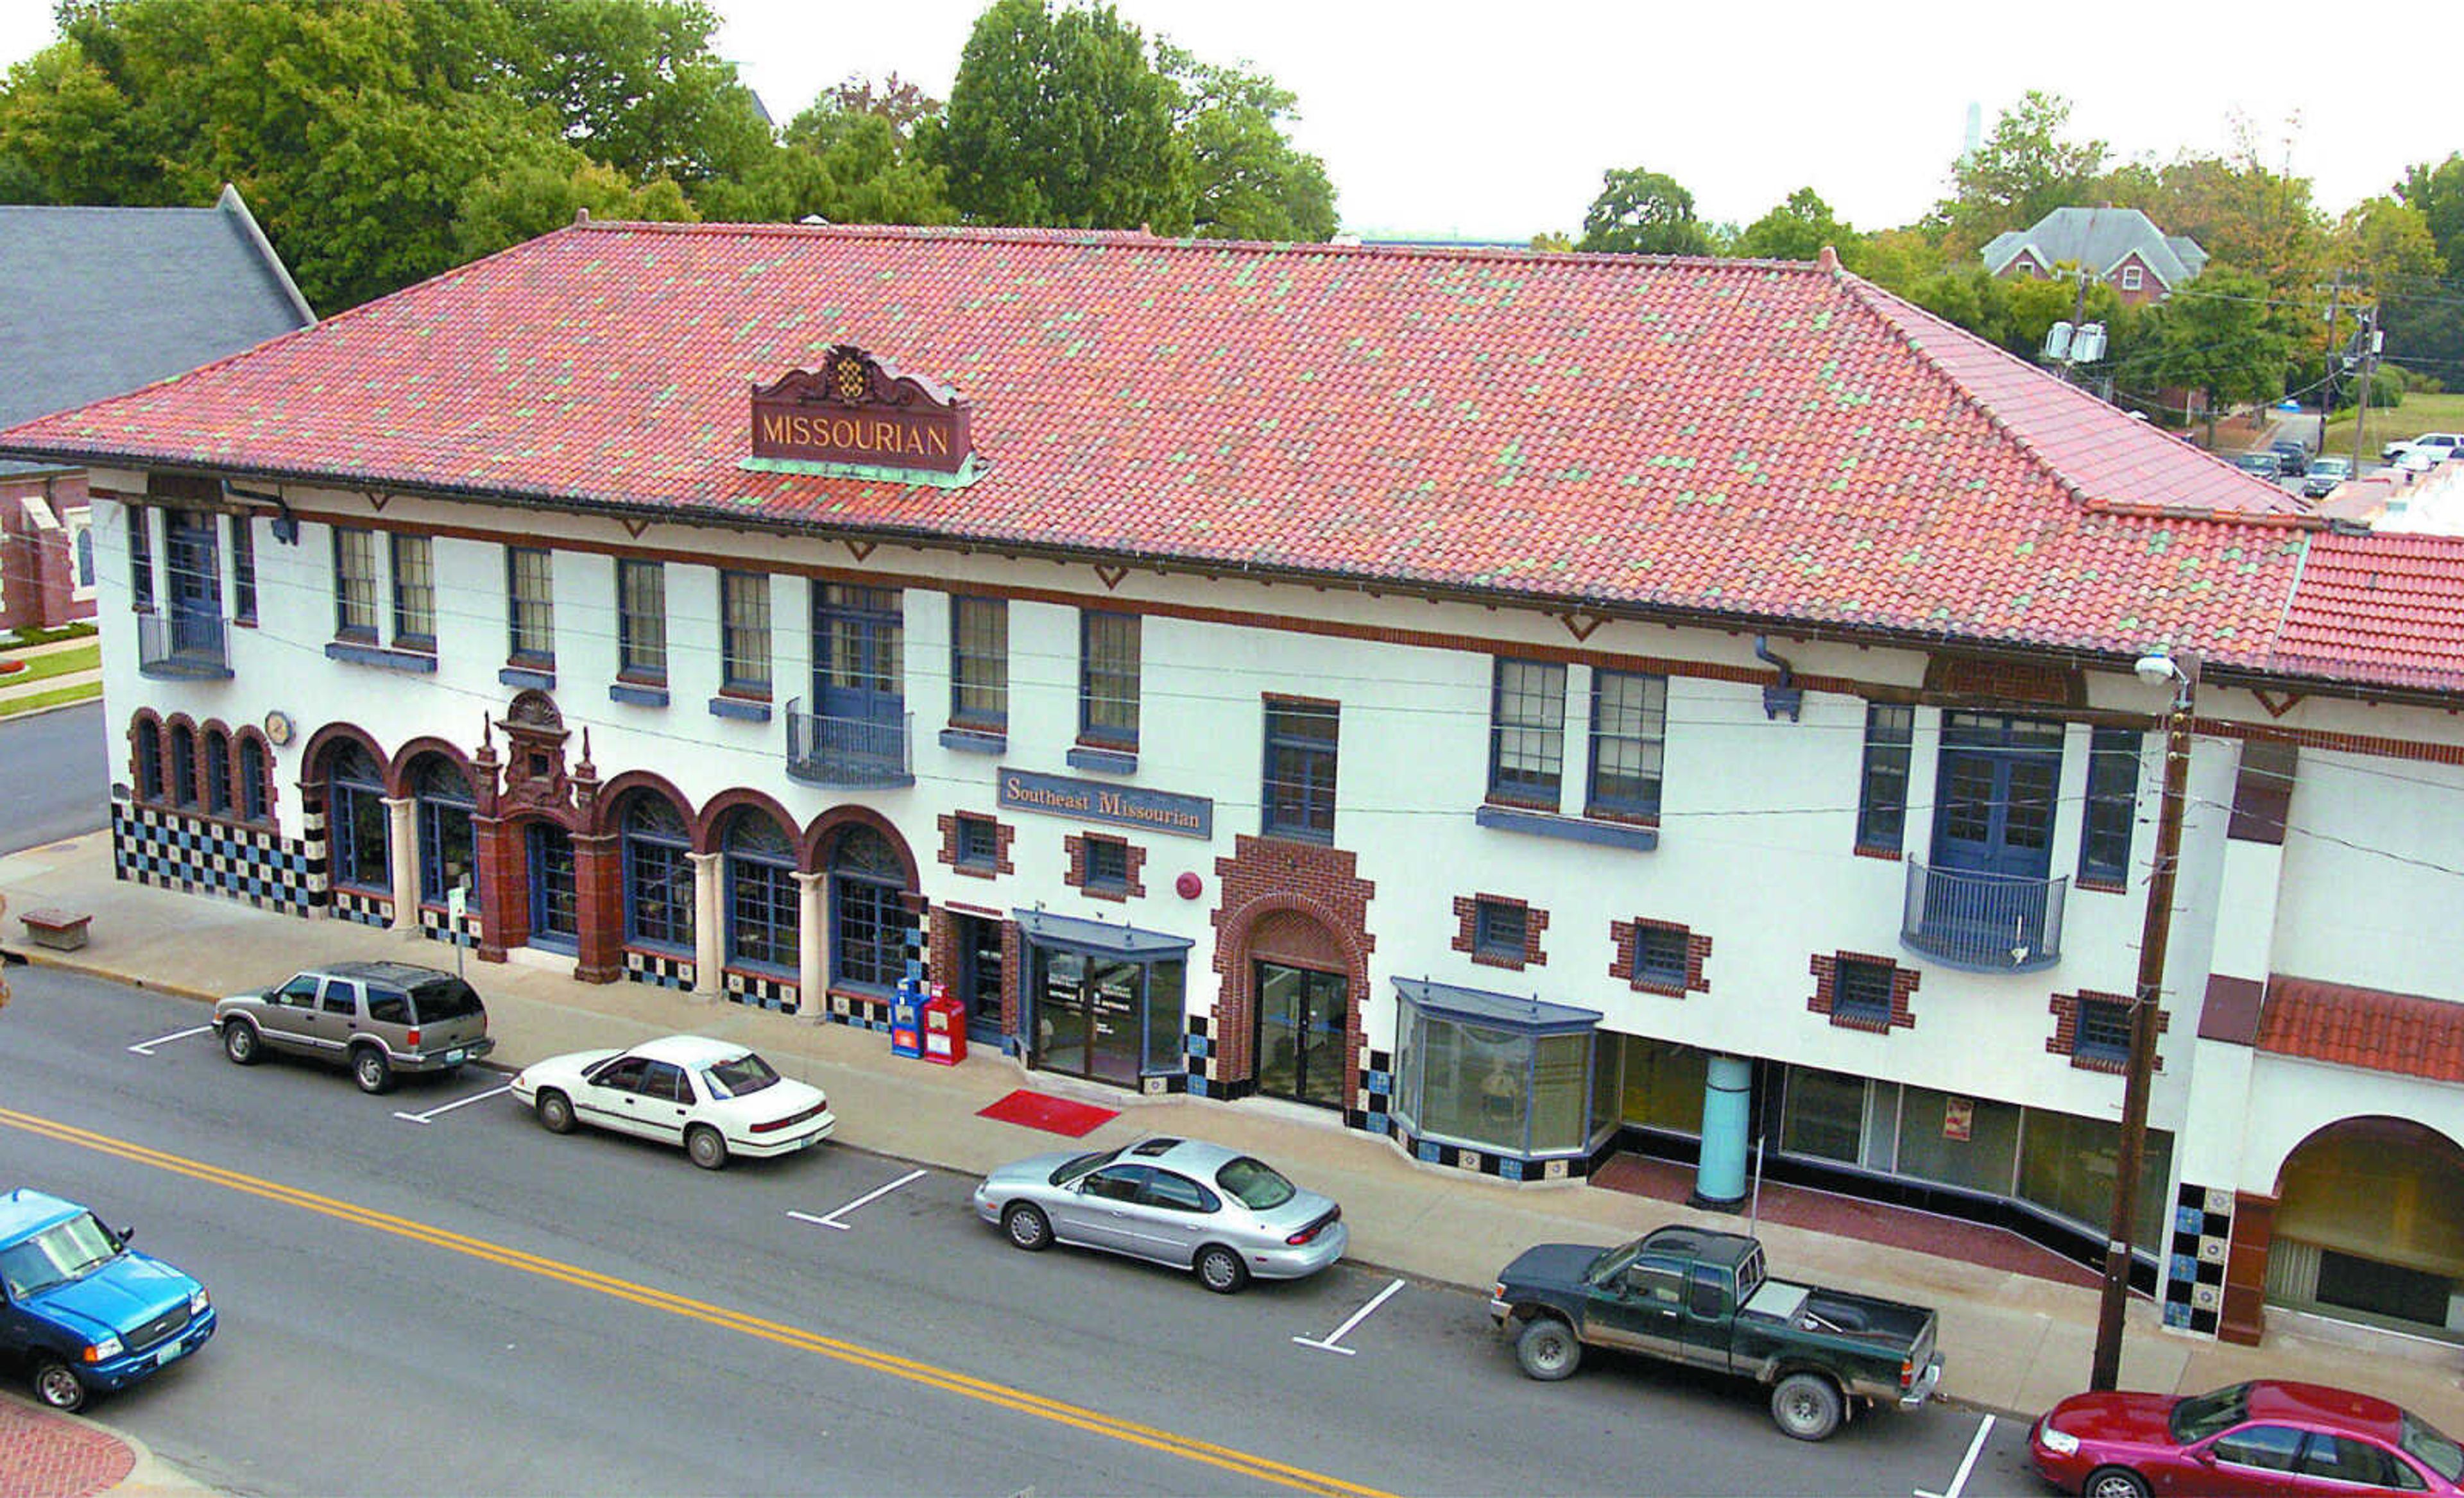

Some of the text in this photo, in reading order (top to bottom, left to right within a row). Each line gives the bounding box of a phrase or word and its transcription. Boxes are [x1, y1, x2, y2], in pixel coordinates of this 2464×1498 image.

[763, 414, 948, 456] MISSOURIAN
[1007, 777, 1200, 828] Southeast Missourian
